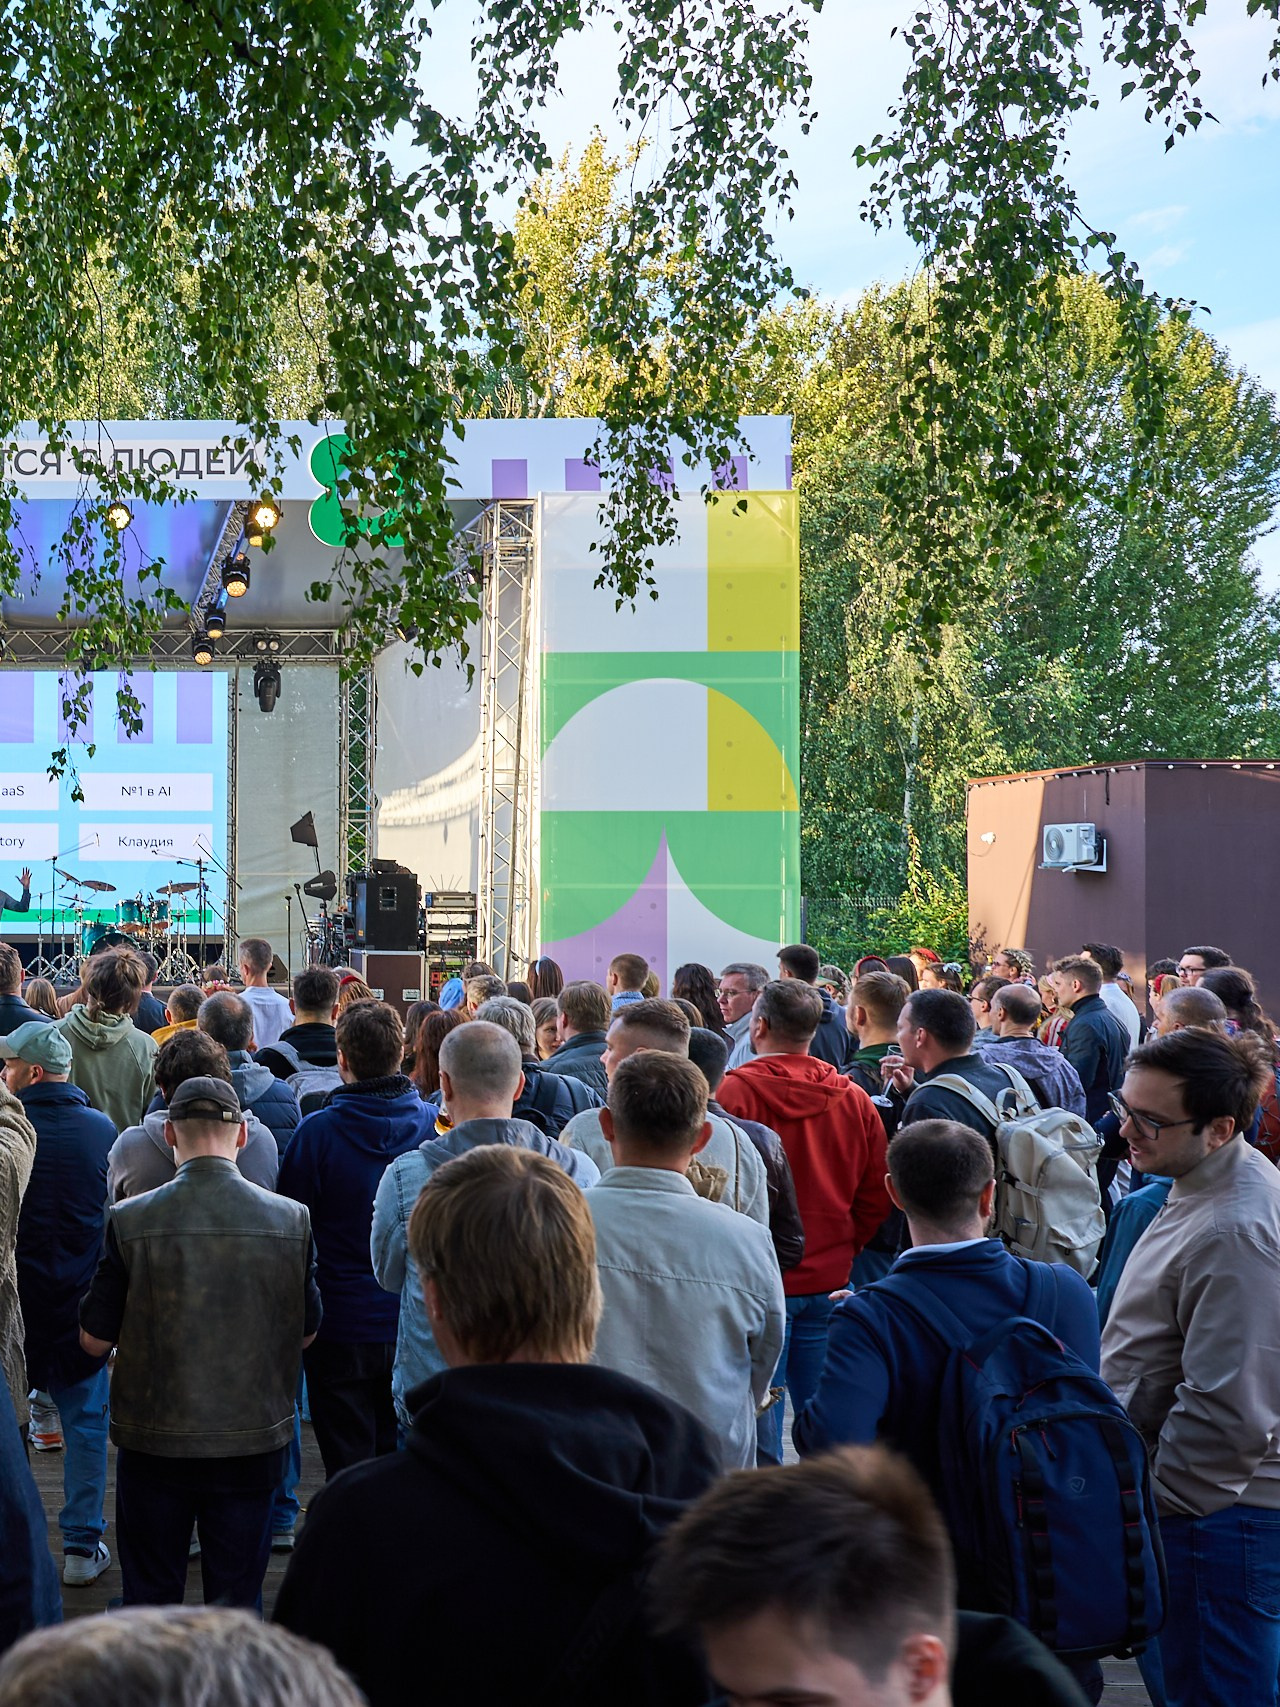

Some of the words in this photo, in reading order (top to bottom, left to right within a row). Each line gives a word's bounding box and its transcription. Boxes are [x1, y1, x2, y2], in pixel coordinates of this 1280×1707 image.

[121, 785, 143, 797] №1
[147, 788, 155, 797] в
[158, 785, 171, 797] AI
[118, 835, 174, 849] Клаудия
